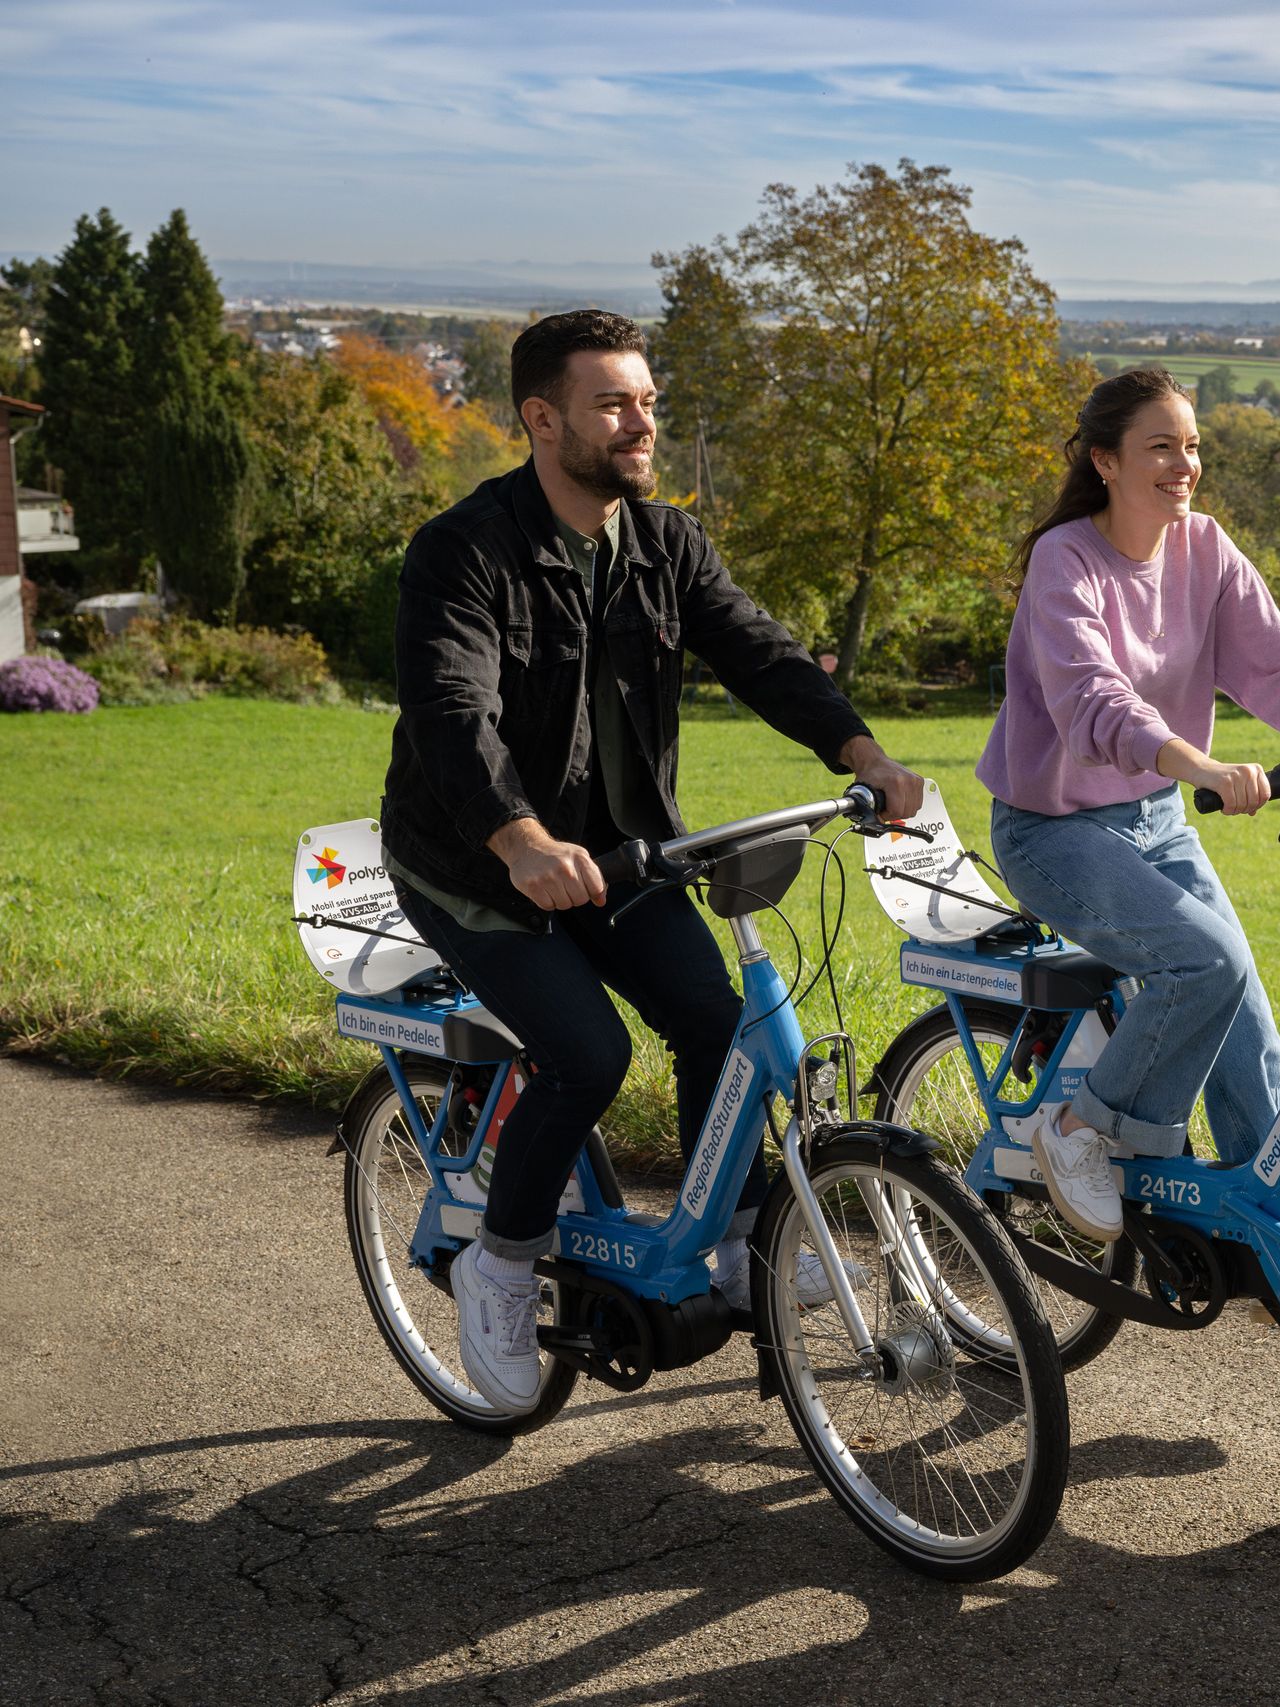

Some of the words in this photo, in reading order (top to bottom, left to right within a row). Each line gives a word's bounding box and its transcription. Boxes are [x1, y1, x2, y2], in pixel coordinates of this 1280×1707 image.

[878, 853, 898, 864] Mobil
[898, 851, 912, 860] sein
[912, 848, 925, 858] und
[925, 846, 946, 857] sparen
[903, 858, 934, 870] VVS-Abo
[934, 857, 945, 865] auf
[348, 865, 387, 885] polyg
[311, 900, 335, 912] Mobil
[336, 898, 353, 908] sein
[353, 893, 369, 904] und
[369, 889, 395, 903] sparen
[341, 903, 380, 918] VVS-Abo
[380, 900, 393, 910] auf
[906, 961, 919, 975] Ich
[920, 963, 934, 978] bin
[935, 967, 950, 980] ein
[951, 969, 1018, 992] Lastenpedelec
[342, 1010, 358, 1029] Ich
[359, 1015, 377, 1033] bin
[378, 1022, 395, 1037] ein
[397, 1024, 440, 1049] Pedelec
[1061, 1076, 1080, 1085] Hier
[1061, 1087, 1080, 1096] Wer
[686, 1057, 748, 1211] RegioRadStuttgart
[1030, 1167, 1044, 1182] Ca
[1139, 1174, 1201, 1206] 24173
[571, 1231, 636, 1269] 22815
